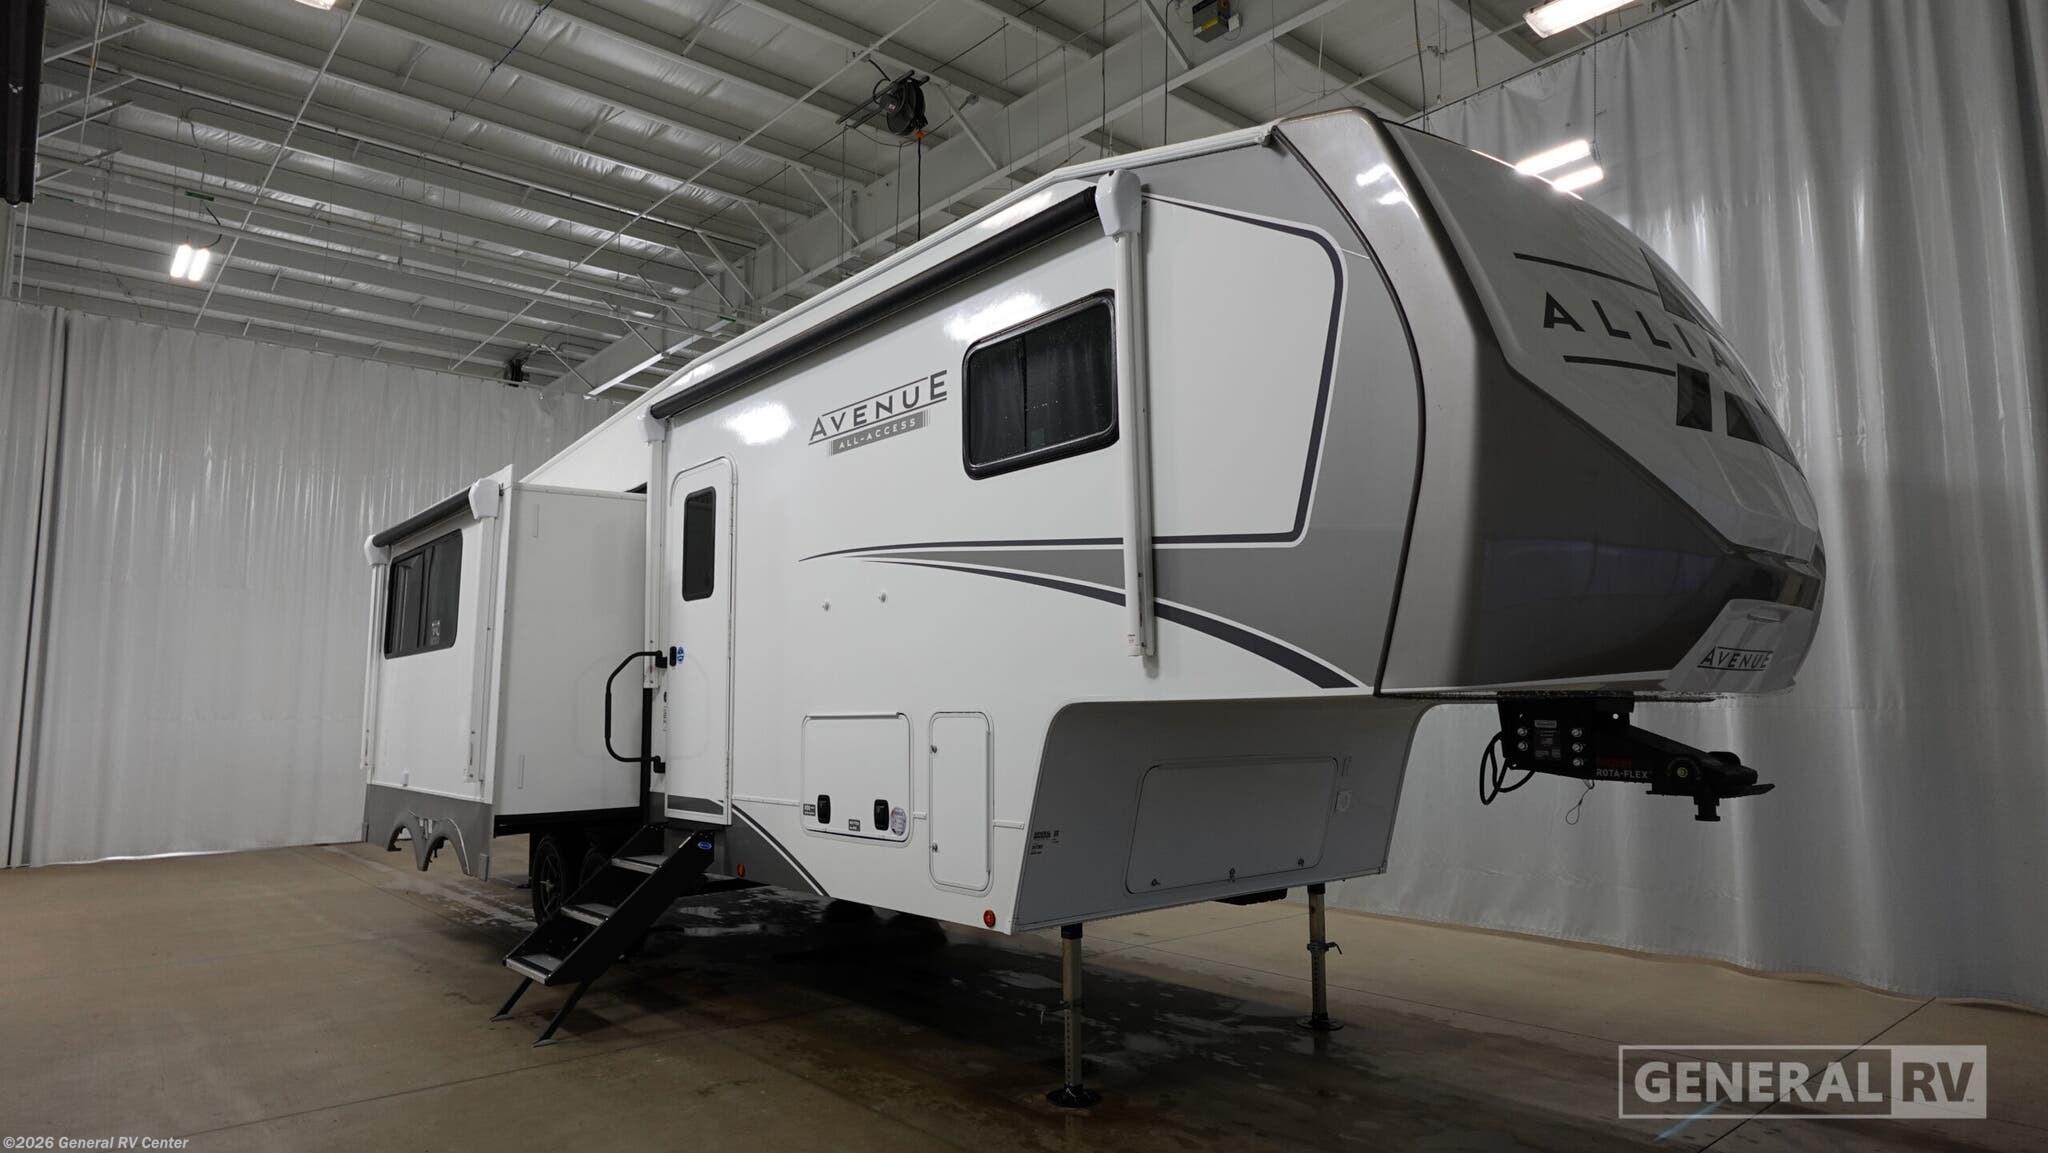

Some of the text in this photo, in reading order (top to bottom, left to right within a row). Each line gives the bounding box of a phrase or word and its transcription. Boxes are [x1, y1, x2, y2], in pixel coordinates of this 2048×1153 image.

[809, 369, 948, 441] AVENUE
[838, 417, 917, 450] ALL-ACCESS
[1701, 648, 1773, 671] AVENUE
[1595, 767, 1648, 779] ROTA-FLEX
